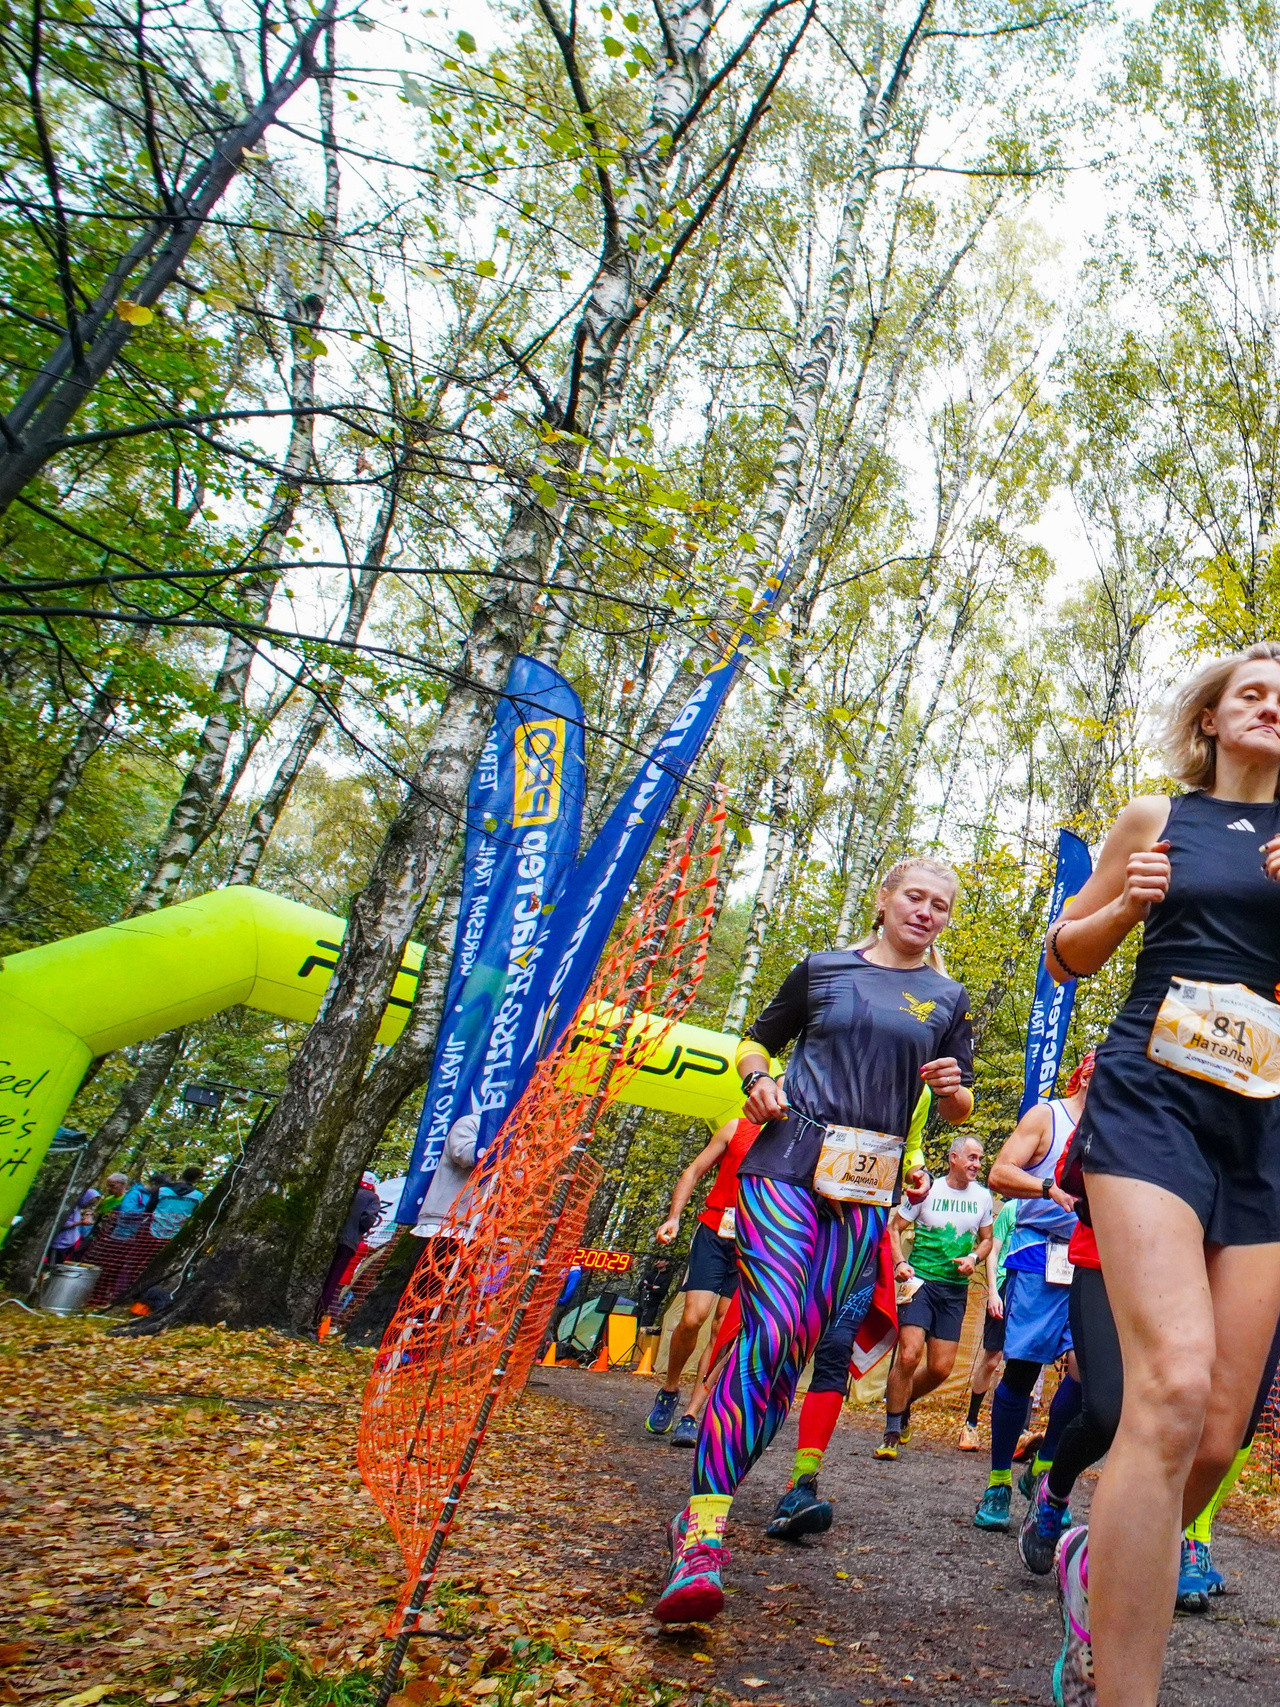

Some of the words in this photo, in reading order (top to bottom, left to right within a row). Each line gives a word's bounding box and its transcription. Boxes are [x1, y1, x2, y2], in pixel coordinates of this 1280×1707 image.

[1211, 1016, 1246, 1048] 81
[1190, 1033, 1253, 1068] Наталья
[854, 1154, 878, 1174] 37
[842, 1172, 878, 1187] Людмила
[931, 1198, 978, 1215] IZMYLONG
